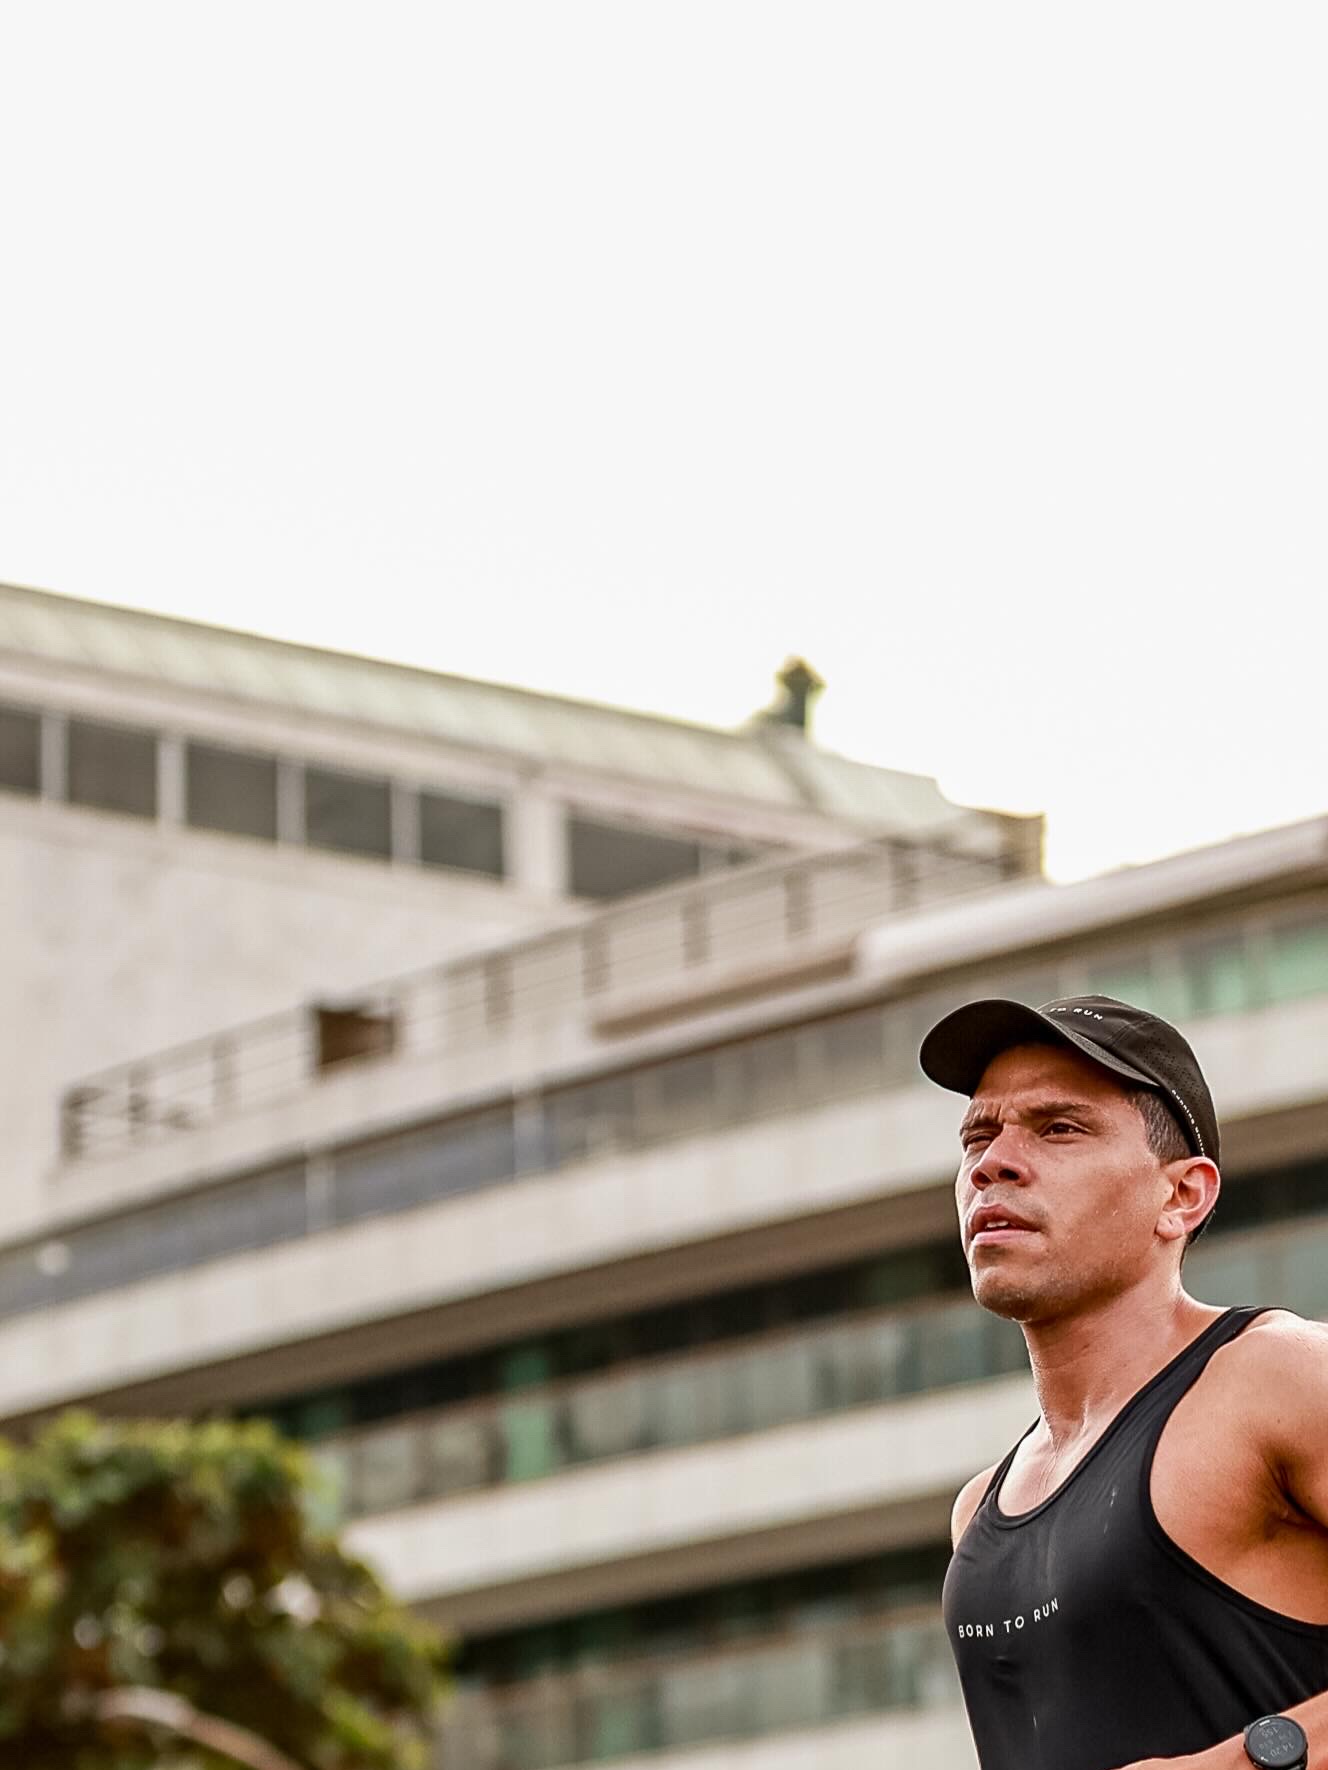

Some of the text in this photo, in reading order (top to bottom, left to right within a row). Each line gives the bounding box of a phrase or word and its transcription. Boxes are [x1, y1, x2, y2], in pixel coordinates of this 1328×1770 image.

[1073, 1007, 1103, 1020] RUN
[958, 1597, 1059, 1638] BORN TO RUN
